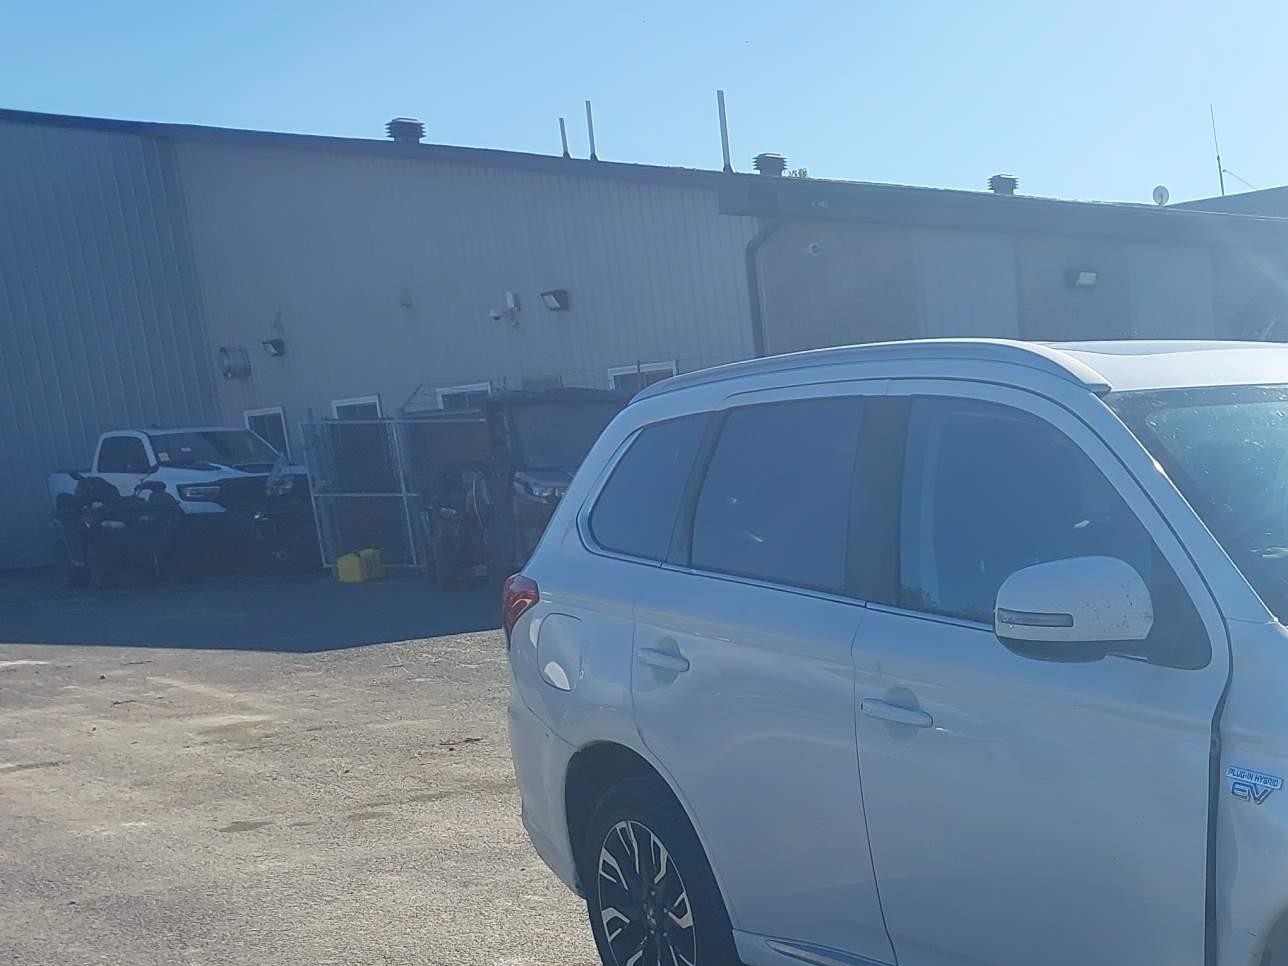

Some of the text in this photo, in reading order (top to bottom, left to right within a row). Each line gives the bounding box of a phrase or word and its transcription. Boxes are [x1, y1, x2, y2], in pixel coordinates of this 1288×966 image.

[1228, 767, 1279, 787] PLUG-IN HYBRID
[1231, 781, 1274, 805] EV
